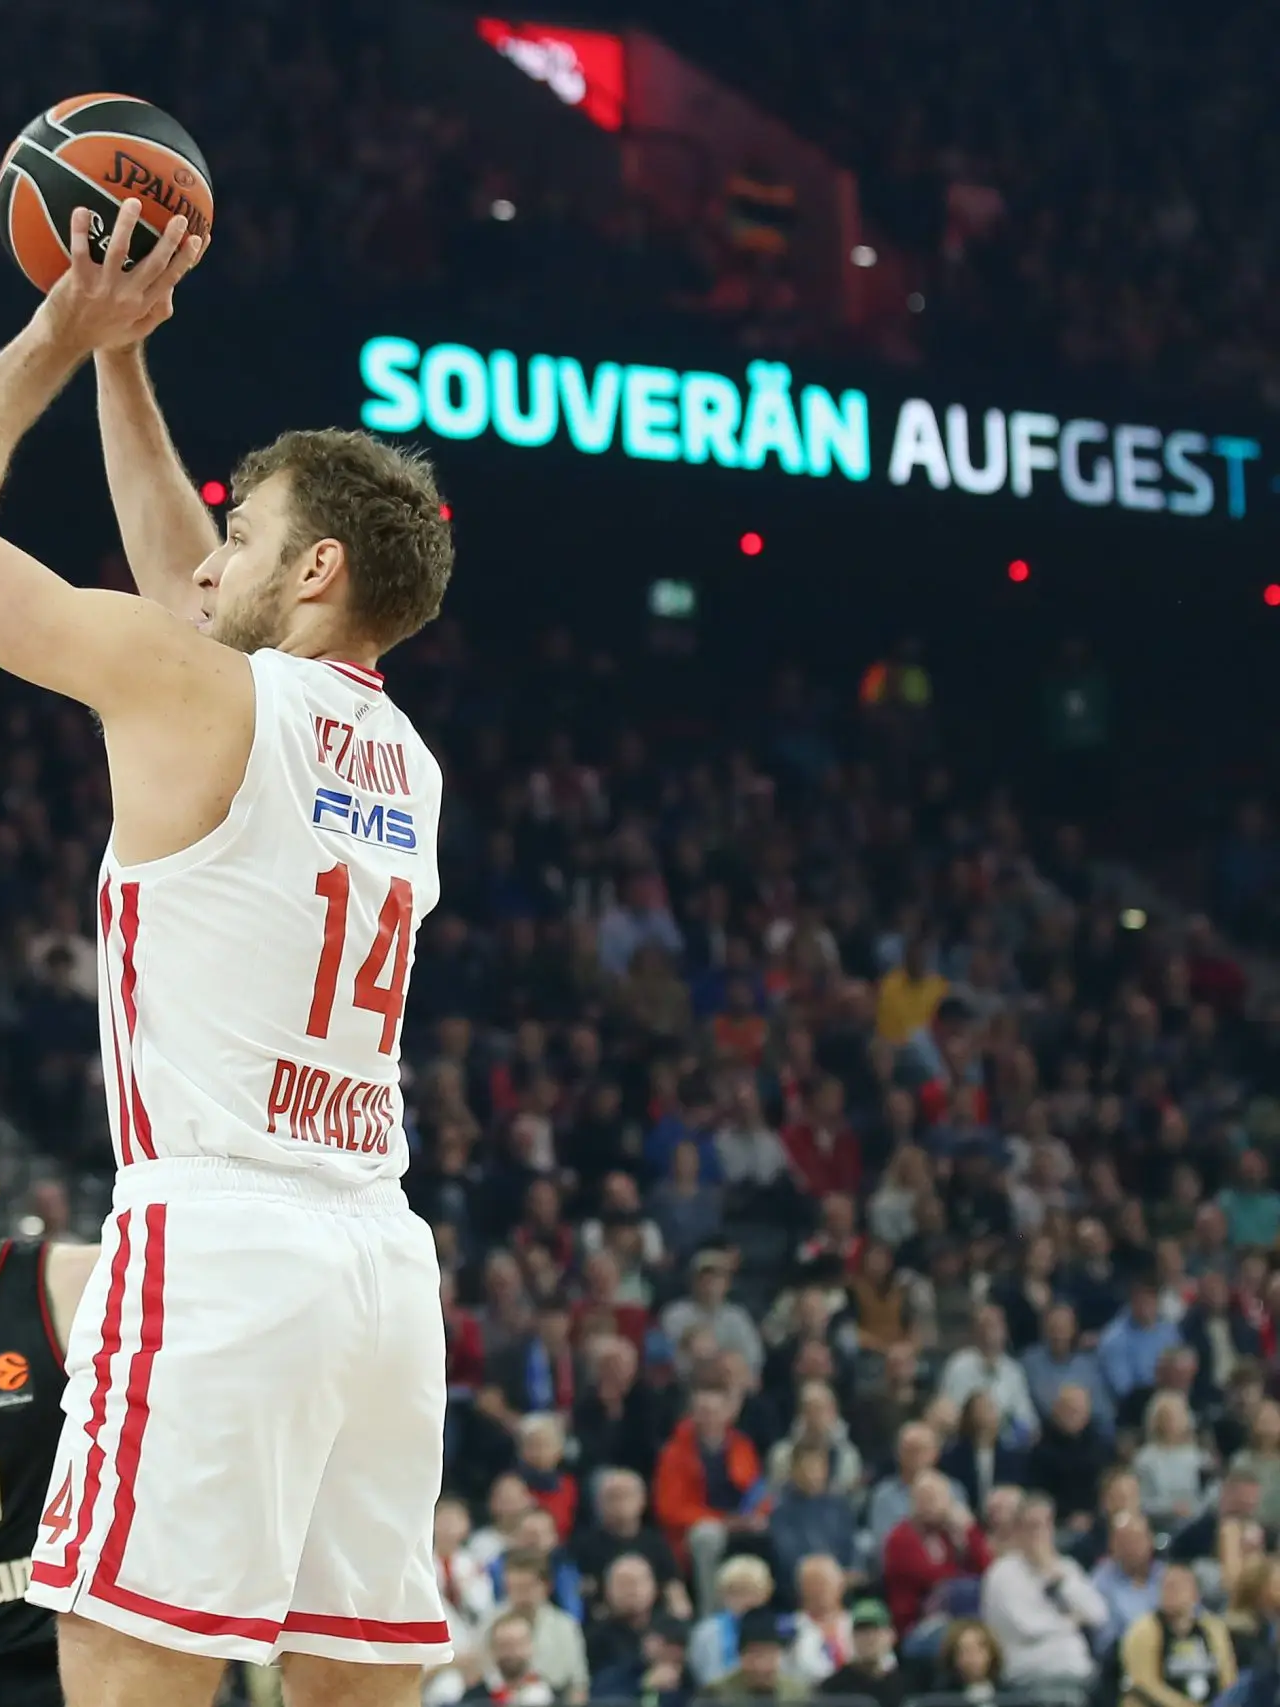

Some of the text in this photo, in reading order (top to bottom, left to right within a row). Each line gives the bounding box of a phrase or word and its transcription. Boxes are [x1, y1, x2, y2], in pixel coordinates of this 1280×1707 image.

[360, 336, 870, 481] SOUVERÄN
[313, 787, 417, 849] FMS
[306, 861, 413, 1056] 14
[267, 1058, 394, 1155] PIRAEUS
[41, 1459, 72, 1544] 4
